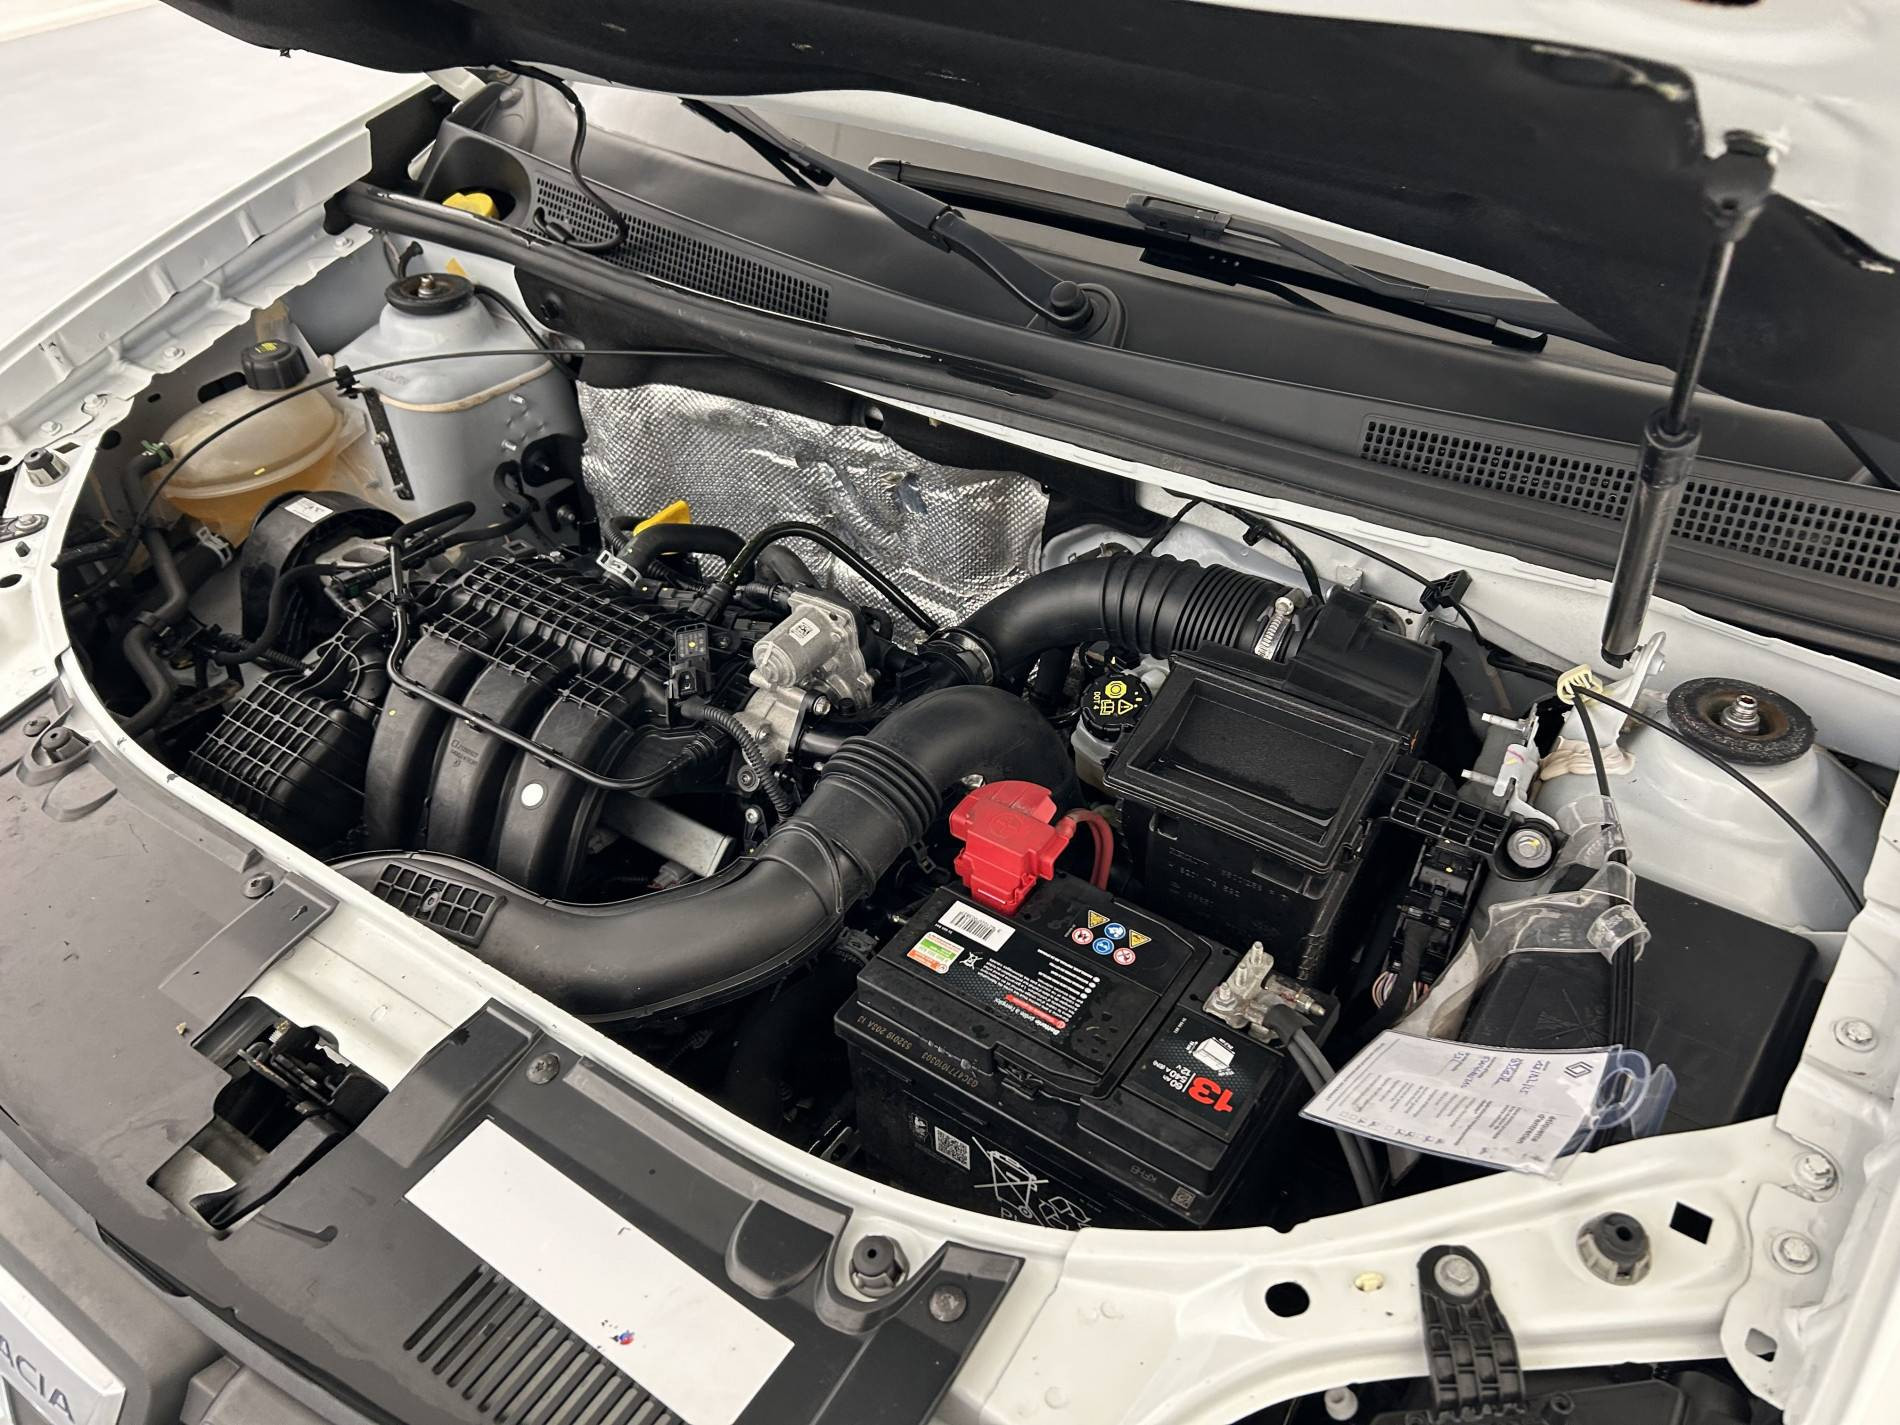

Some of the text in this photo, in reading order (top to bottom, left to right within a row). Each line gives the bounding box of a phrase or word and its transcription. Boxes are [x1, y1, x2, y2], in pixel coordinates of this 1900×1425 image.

[1093, 692, 1101, 704] DOT
[1169, 1070, 1188, 1084] 540
[1180, 1066, 1191, 1077] 12
[1169, 1079, 1183, 1091] 60
[1188, 1076, 1233, 1113] 13
